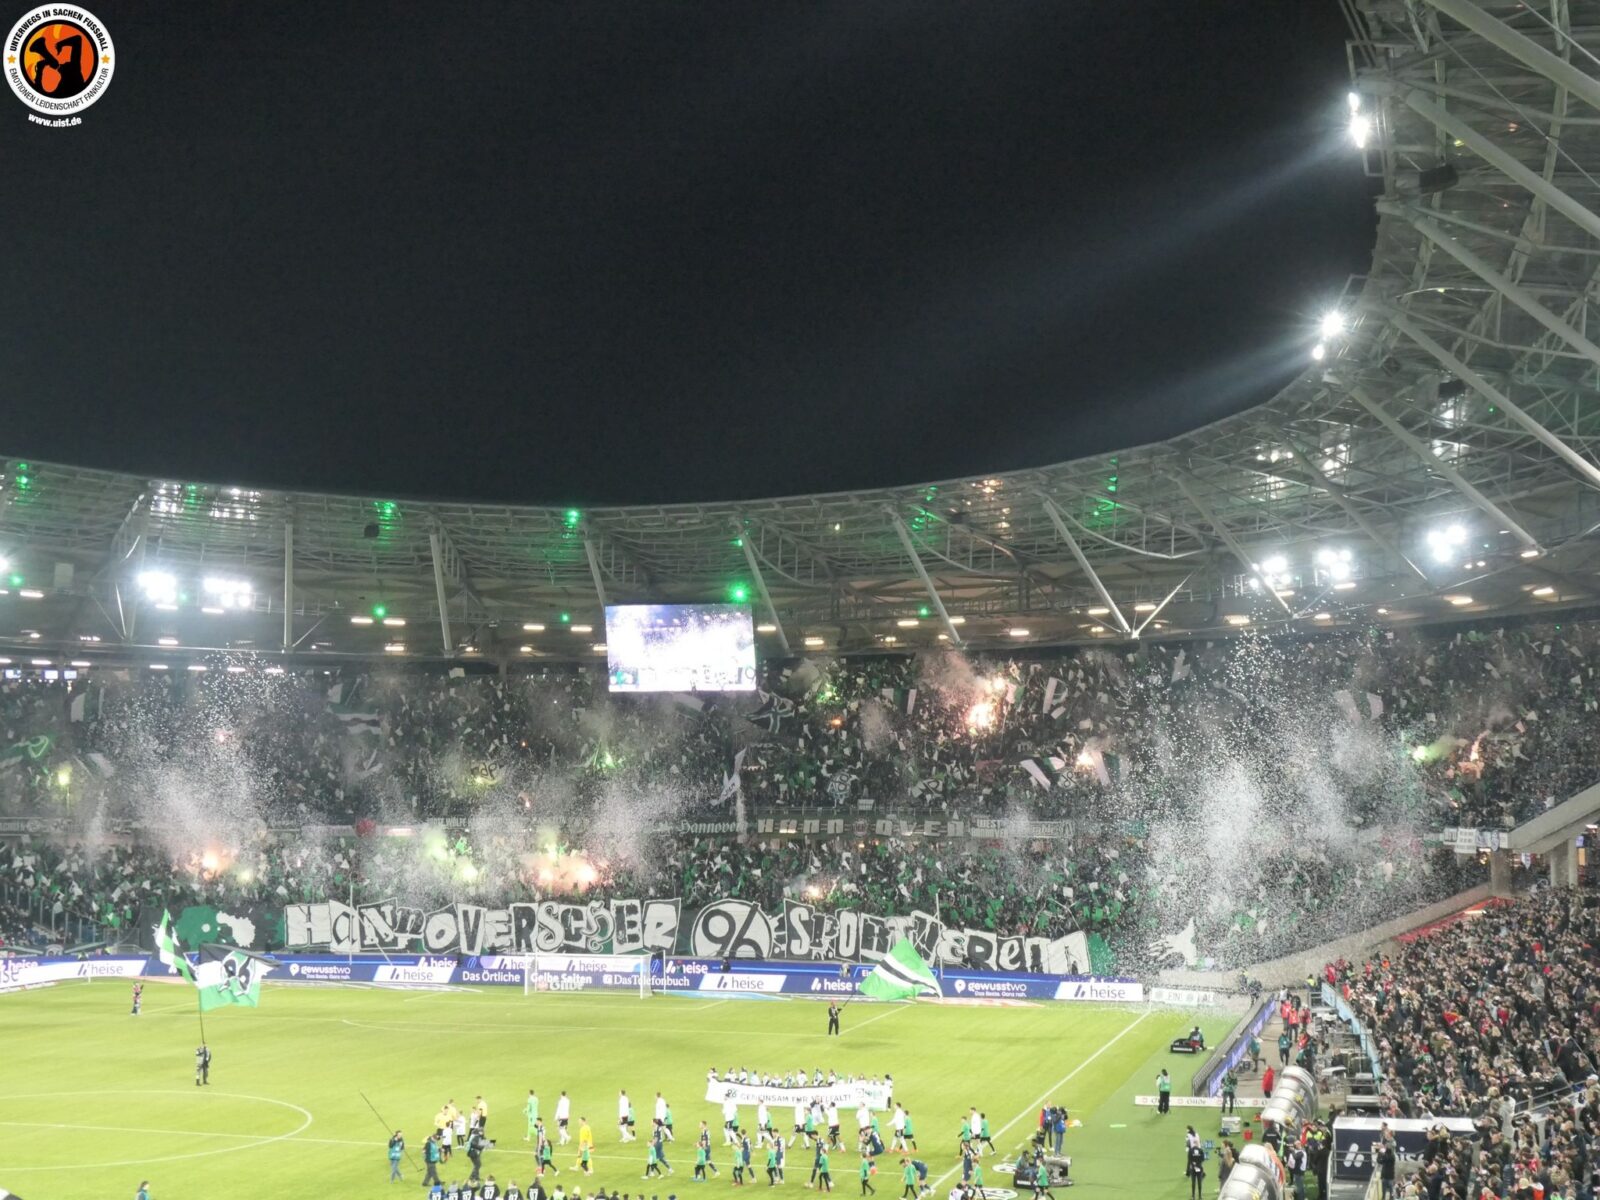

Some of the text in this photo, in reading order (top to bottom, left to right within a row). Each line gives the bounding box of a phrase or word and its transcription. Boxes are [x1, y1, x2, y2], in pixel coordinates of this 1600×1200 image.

[90, 962, 124, 977] heise
[301, 965, 351, 975] gewusstwo
[403, 966, 433, 981] heise
[462, 968, 521, 983] Das Örtliche
[731, 976, 764, 990] heise
[823, 979, 853, 991] heise
[967, 981, 1028, 992] gewusstwo
[1090, 984, 1126, 999] heise
